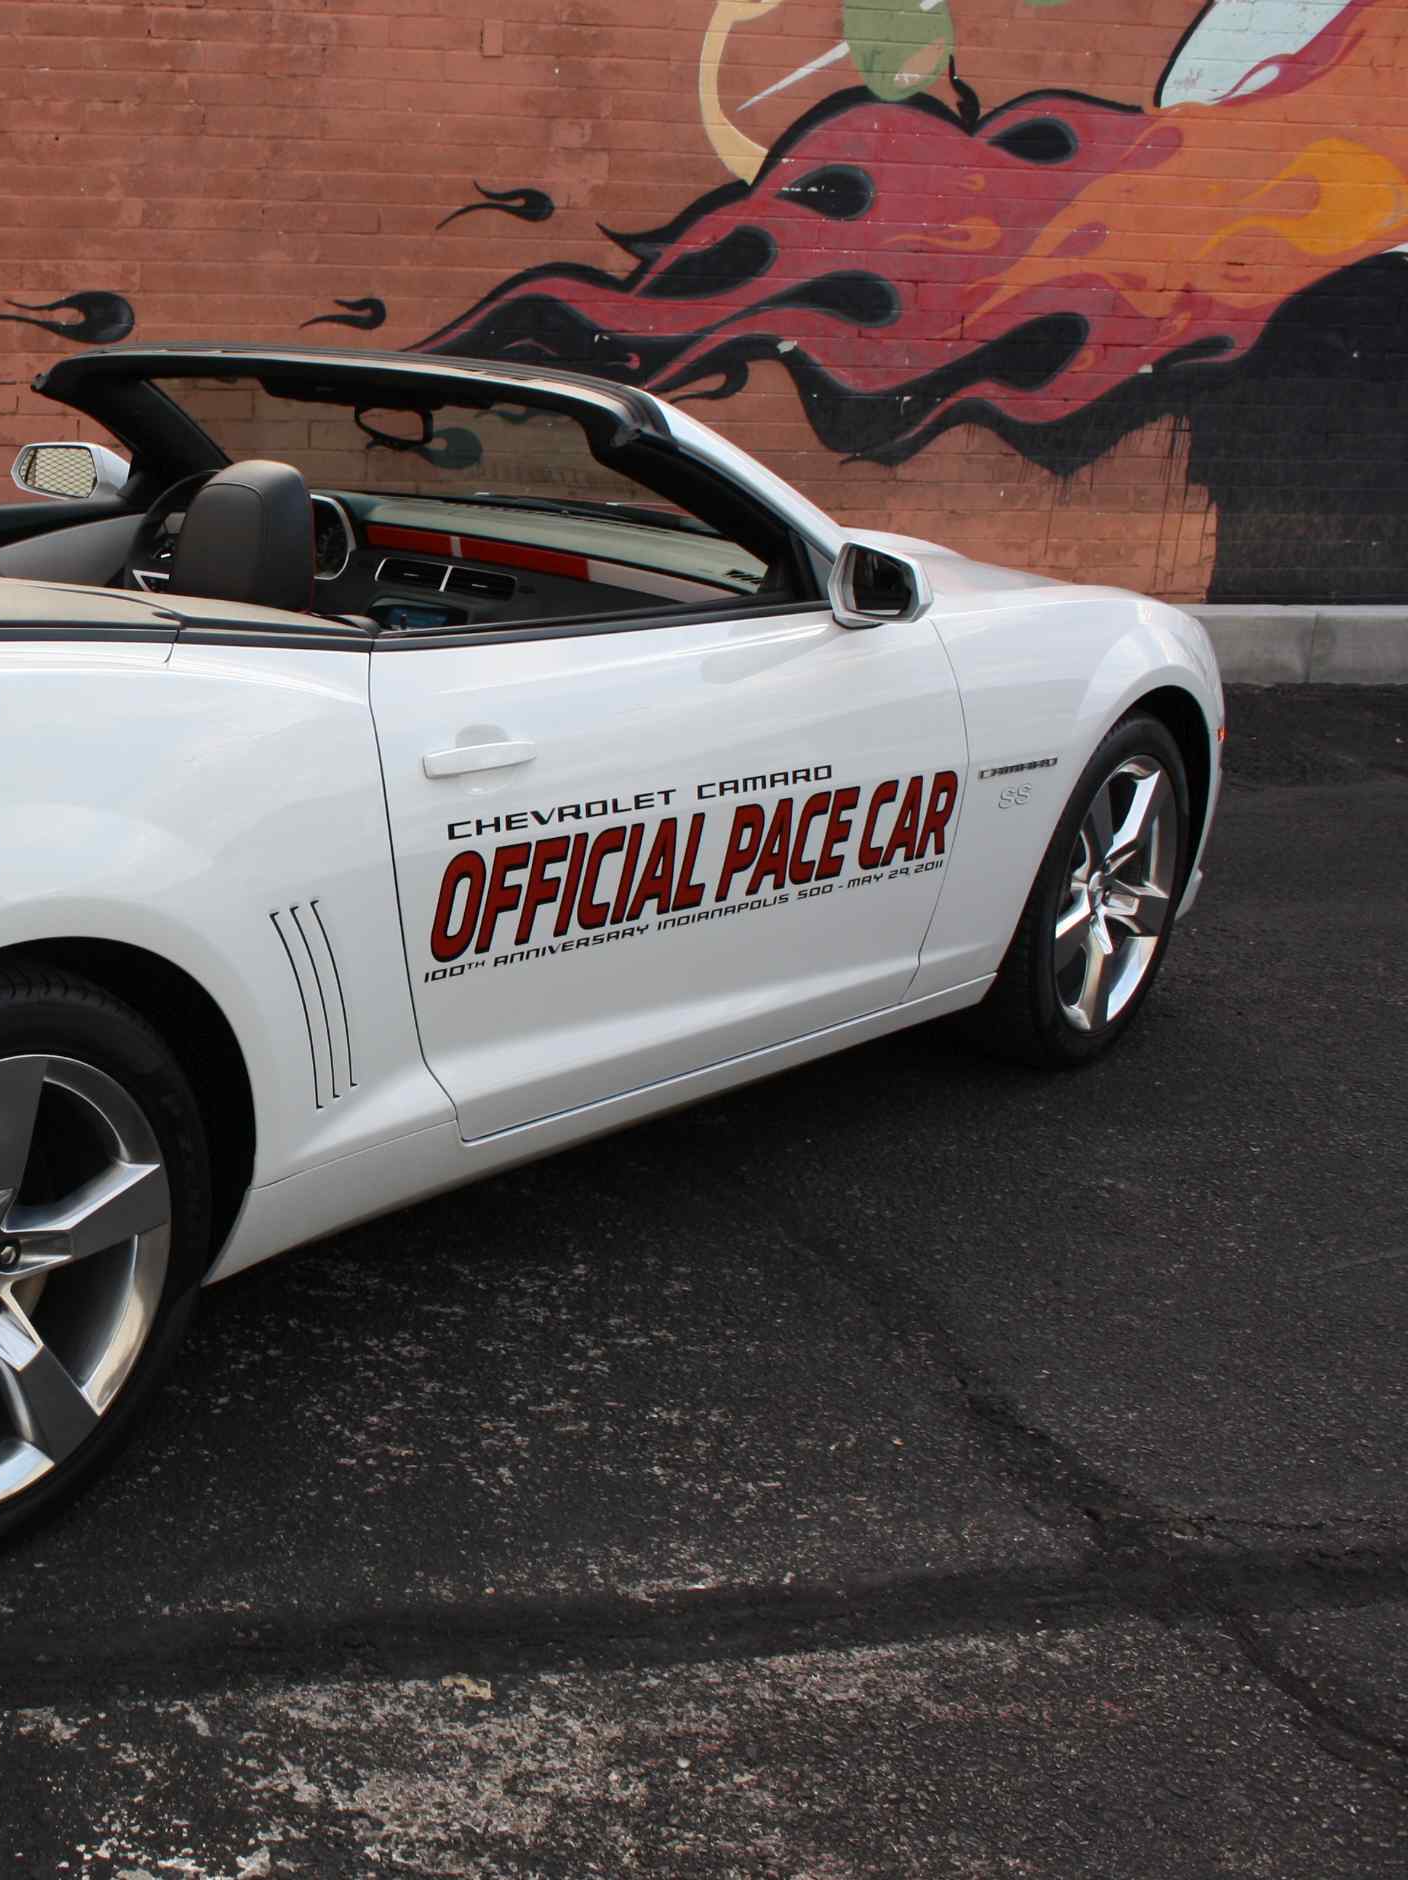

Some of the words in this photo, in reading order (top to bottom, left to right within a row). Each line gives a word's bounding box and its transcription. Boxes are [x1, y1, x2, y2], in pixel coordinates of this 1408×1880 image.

[448, 788, 677, 840] CHEVROLET
[697, 765, 832, 800] CAMARO
[998, 782, 1033, 810] SS
[430, 812, 706, 963] OFFICIAL
[714, 786, 861, 903] PACE
[858, 770, 958, 870] CAR
[424, 960, 486, 983] 100TH
[493, 924, 649, 967] ANNIVERSARY
[656, 893, 790, 931] INDIANAPOLIS
[797, 884, 834, 900] 500
[847, 873, 884, 889] MAY
[914, 860, 944, 875] 2011
